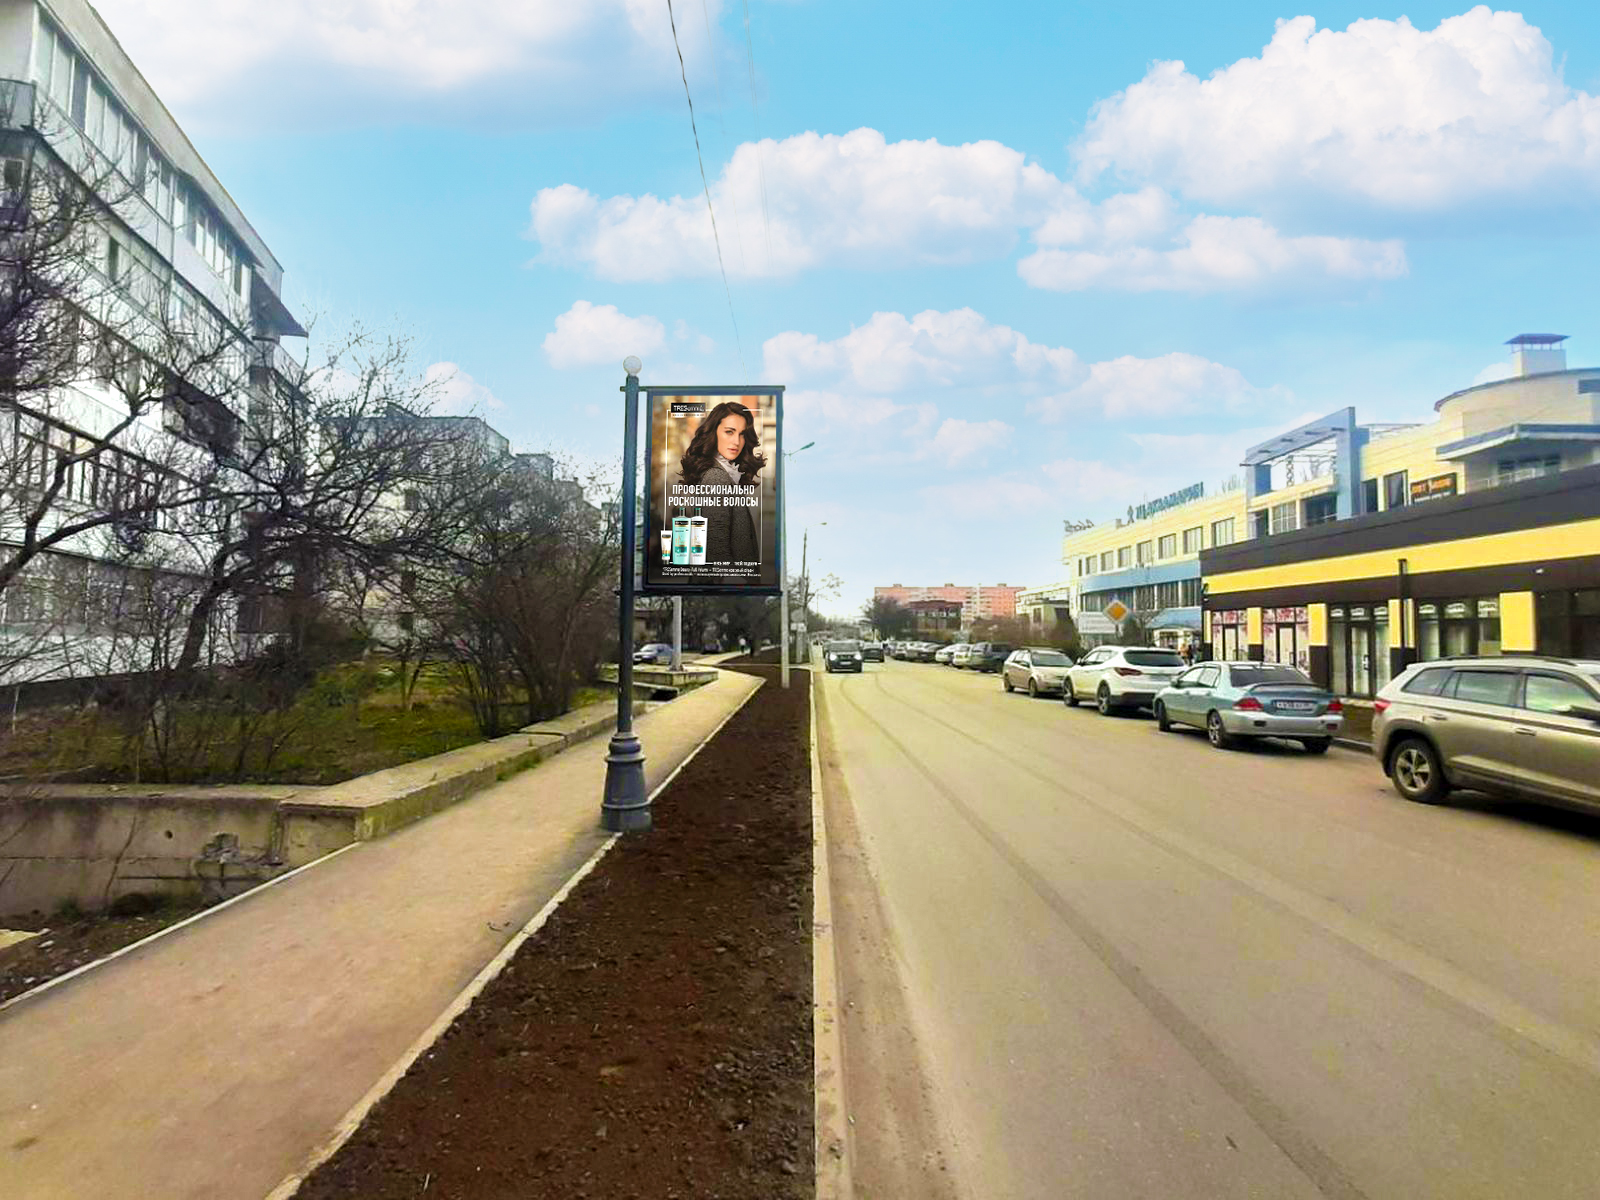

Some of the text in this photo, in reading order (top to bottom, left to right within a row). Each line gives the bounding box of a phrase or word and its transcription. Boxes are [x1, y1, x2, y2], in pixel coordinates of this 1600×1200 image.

[672, 484, 755, 495] ПРОФЕССИОНАЛЬНО
[668, 496, 759, 507] РОСКОШНЫЕ ВОЛОСЫ
